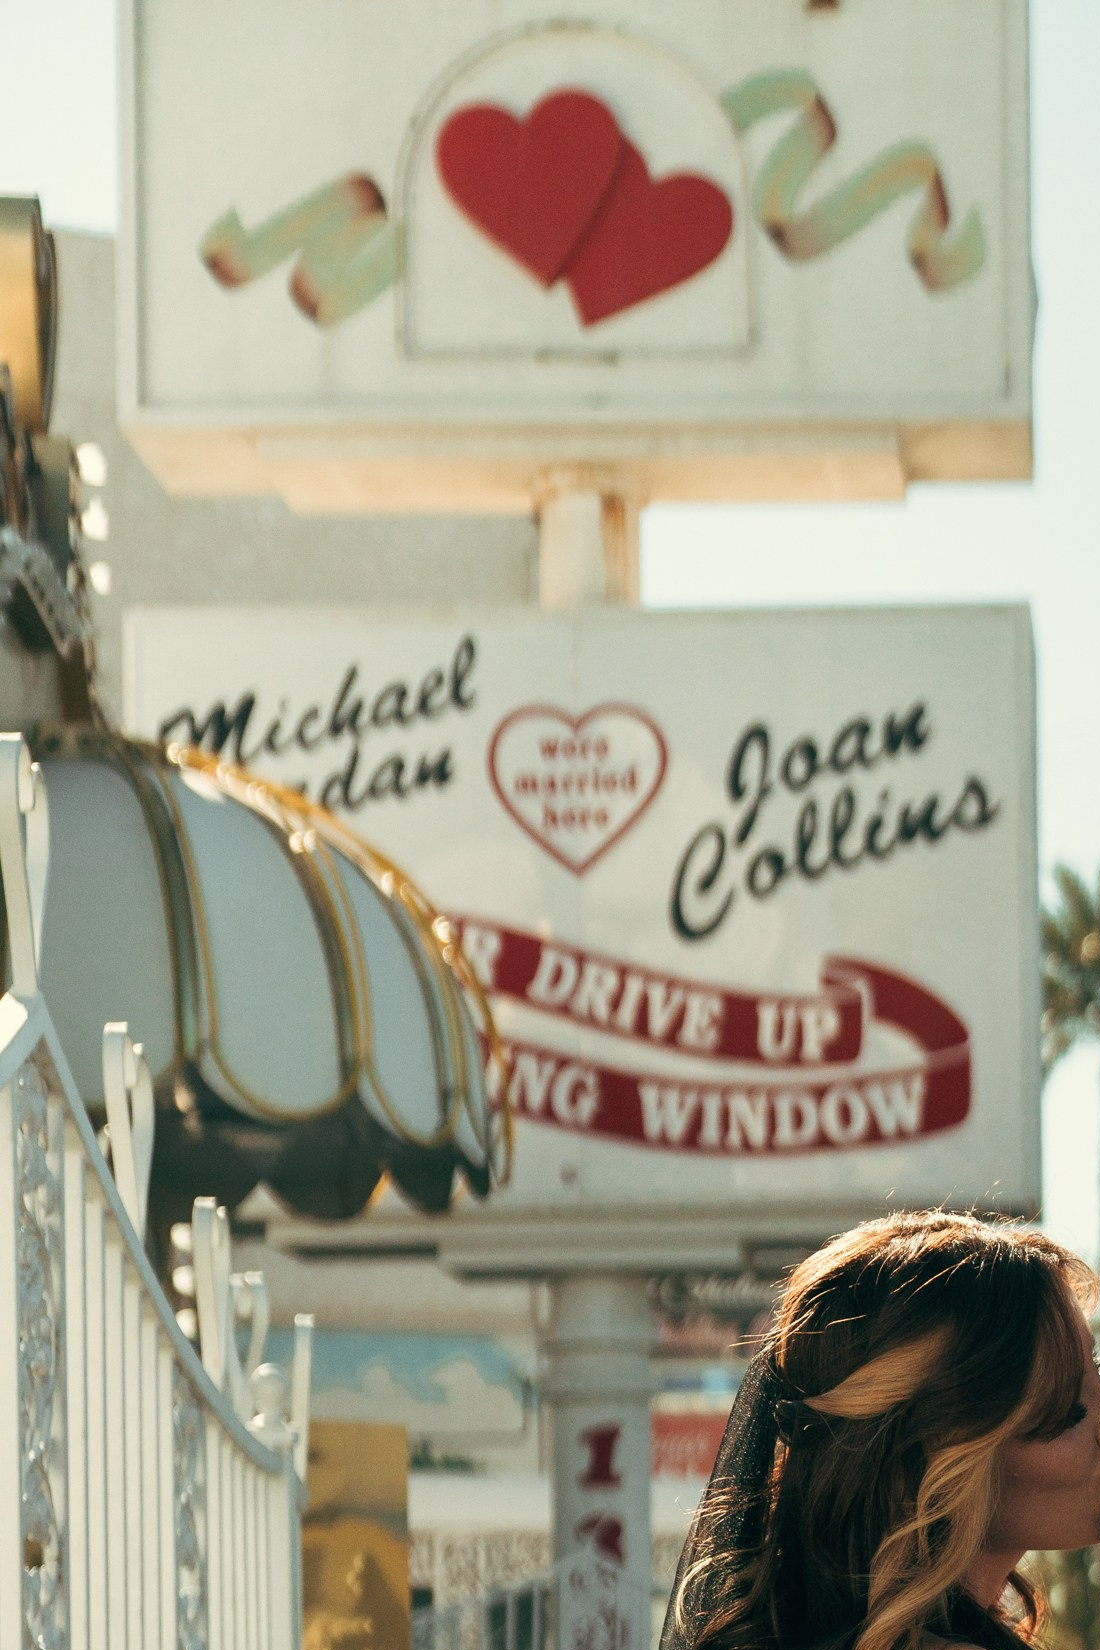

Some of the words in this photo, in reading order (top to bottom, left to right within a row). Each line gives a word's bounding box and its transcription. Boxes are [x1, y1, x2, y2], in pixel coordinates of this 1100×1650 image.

[157, 636, 475, 767] Michael
[296, 747, 453, 811] dan
[513, 765, 637, 794] married
[539, 738, 609, 761] were
[725, 701, 931, 848] Joan
[542, 802, 609, 829] here
[669, 776, 999, 942] Collins
[526, 946, 722, 1050] DRIVE
[756, 1002, 839, 1062] UP
[637, 1073, 924, 1147] WINDOW
